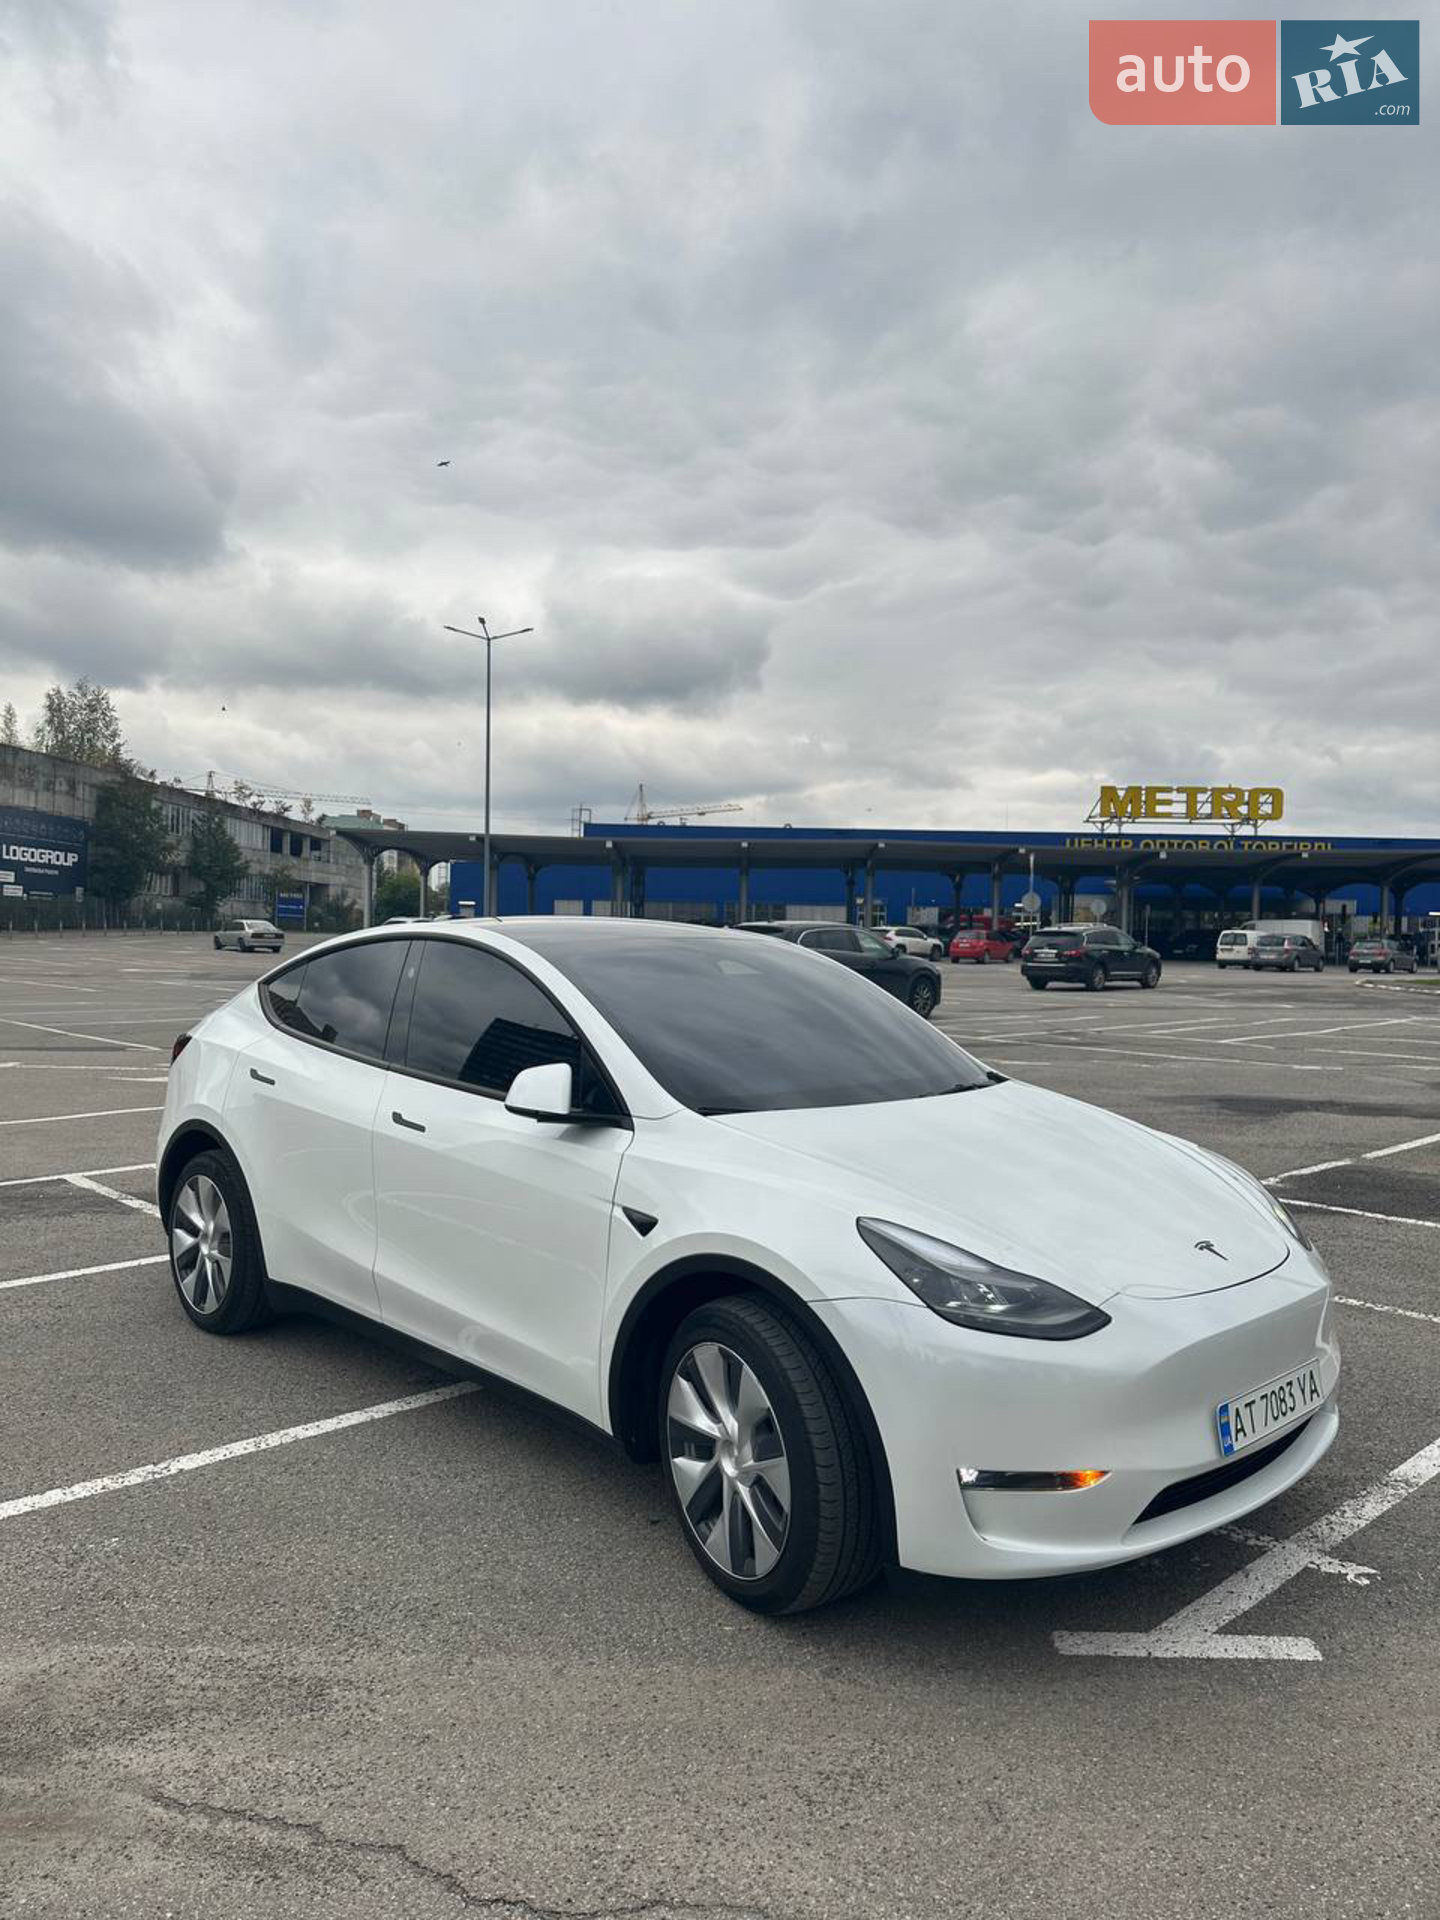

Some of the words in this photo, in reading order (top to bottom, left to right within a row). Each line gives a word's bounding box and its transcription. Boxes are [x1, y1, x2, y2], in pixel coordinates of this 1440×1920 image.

[1099, 785, 1285, 821] METRO
[2, 843, 79, 867] LOGOGROUP
[1234, 1399, 1256, 1442] AT
[1260, 1379, 1297, 1427] 7083
[1297, 1369, 1321, 1406] YA
